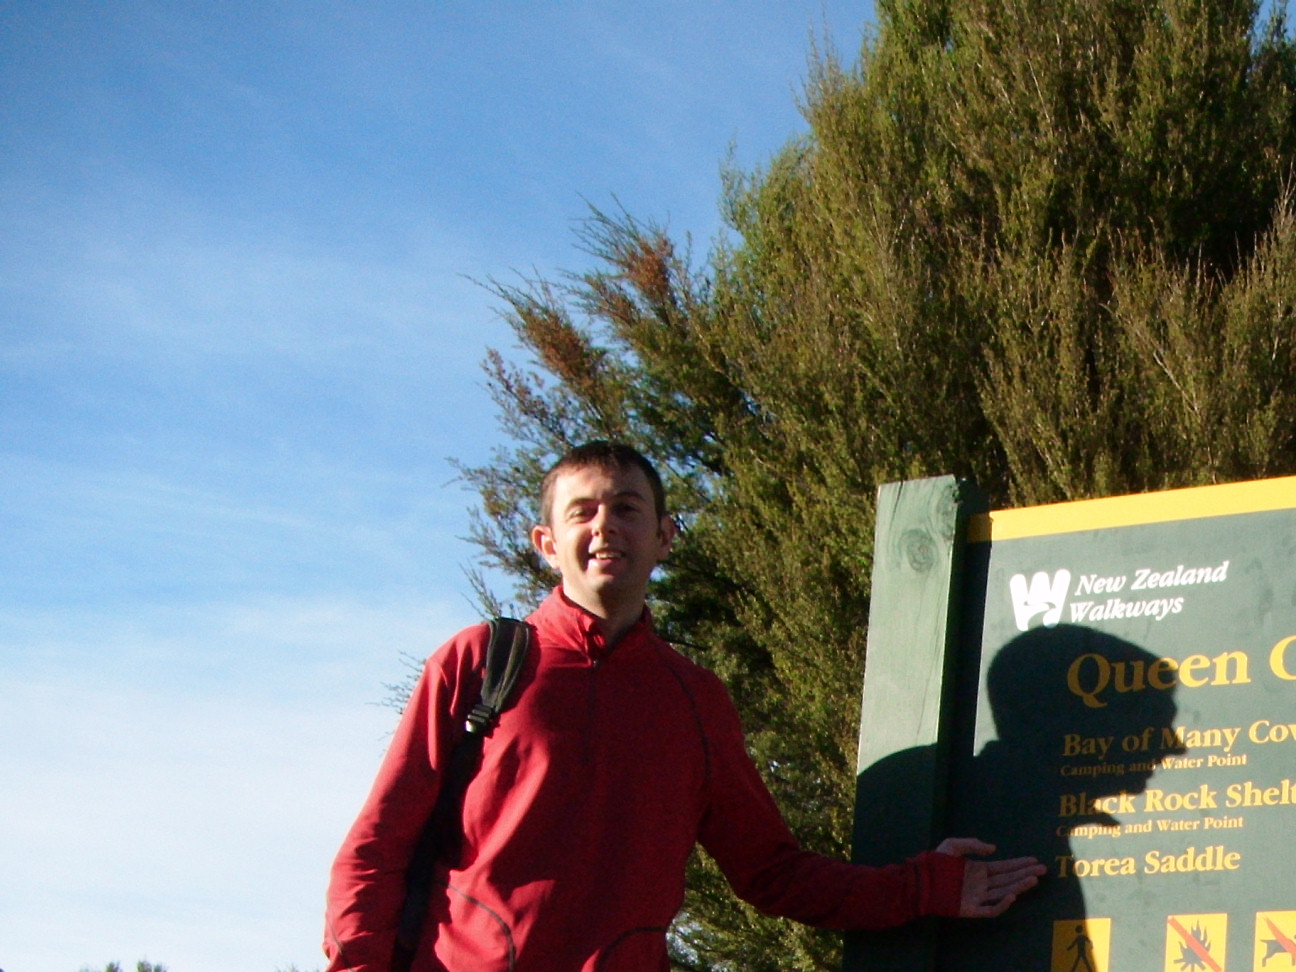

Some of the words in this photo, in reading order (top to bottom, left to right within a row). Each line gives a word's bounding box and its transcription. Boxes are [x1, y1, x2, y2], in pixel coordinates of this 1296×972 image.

[1075, 575, 1126, 595] New
[1131, 561, 1230, 591] Zealand
[1069, 595, 1184, 623] Walkways
[1066, 649, 1251, 708] Queen
[1062, 734, 1114, 759] Bay
[1122, 727, 1154, 751] of
[1160, 726, 1242, 752] Many
[1060, 762, 1125, 777] Camping
[1129, 760, 1157, 772] and
[1161, 756, 1204, 770] Water
[1207, 753, 1247, 767] Point
[1058, 792, 1136, 817] Black
[1144, 784, 1217, 812] Rock
[1056, 823, 1121, 839] Camping
[1125, 821, 1152, 834] and
[1156, 818, 1200, 832] Water
[1203, 816, 1244, 829] Point
[1055, 855, 1136, 878] Torea
[1143, 845, 1241, 874] Saddle
